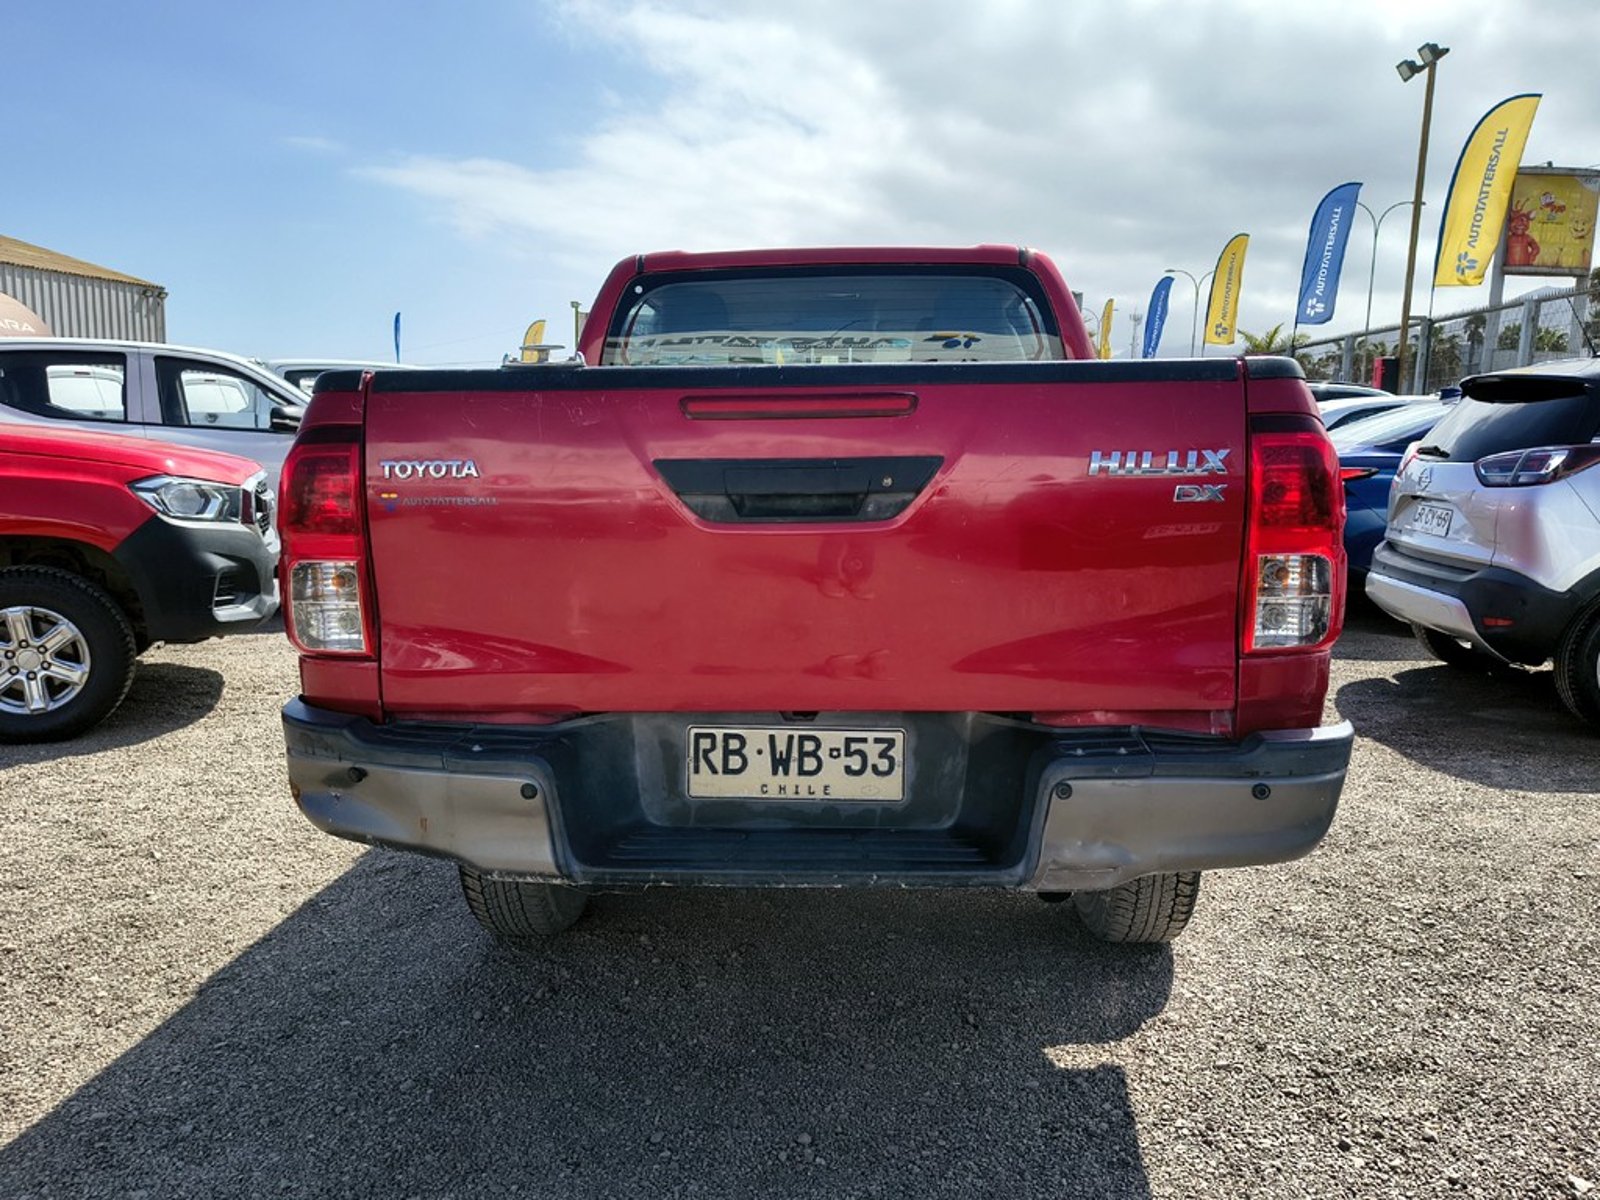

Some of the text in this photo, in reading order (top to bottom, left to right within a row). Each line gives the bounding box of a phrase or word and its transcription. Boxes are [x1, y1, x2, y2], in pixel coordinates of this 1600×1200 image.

[1468, 127, 1508, 248] AUTOTATTERSALL
[1315, 206, 1342, 296] AUTOTATTERSALL
[380, 460, 479, 479] TOYOTA
[1089, 449, 1231, 475] HILUX
[402, 496, 499, 506] AUTOTATTERSALL
[1173, 484, 1228, 502] DX
[760, 784, 832, 796] CHILE
